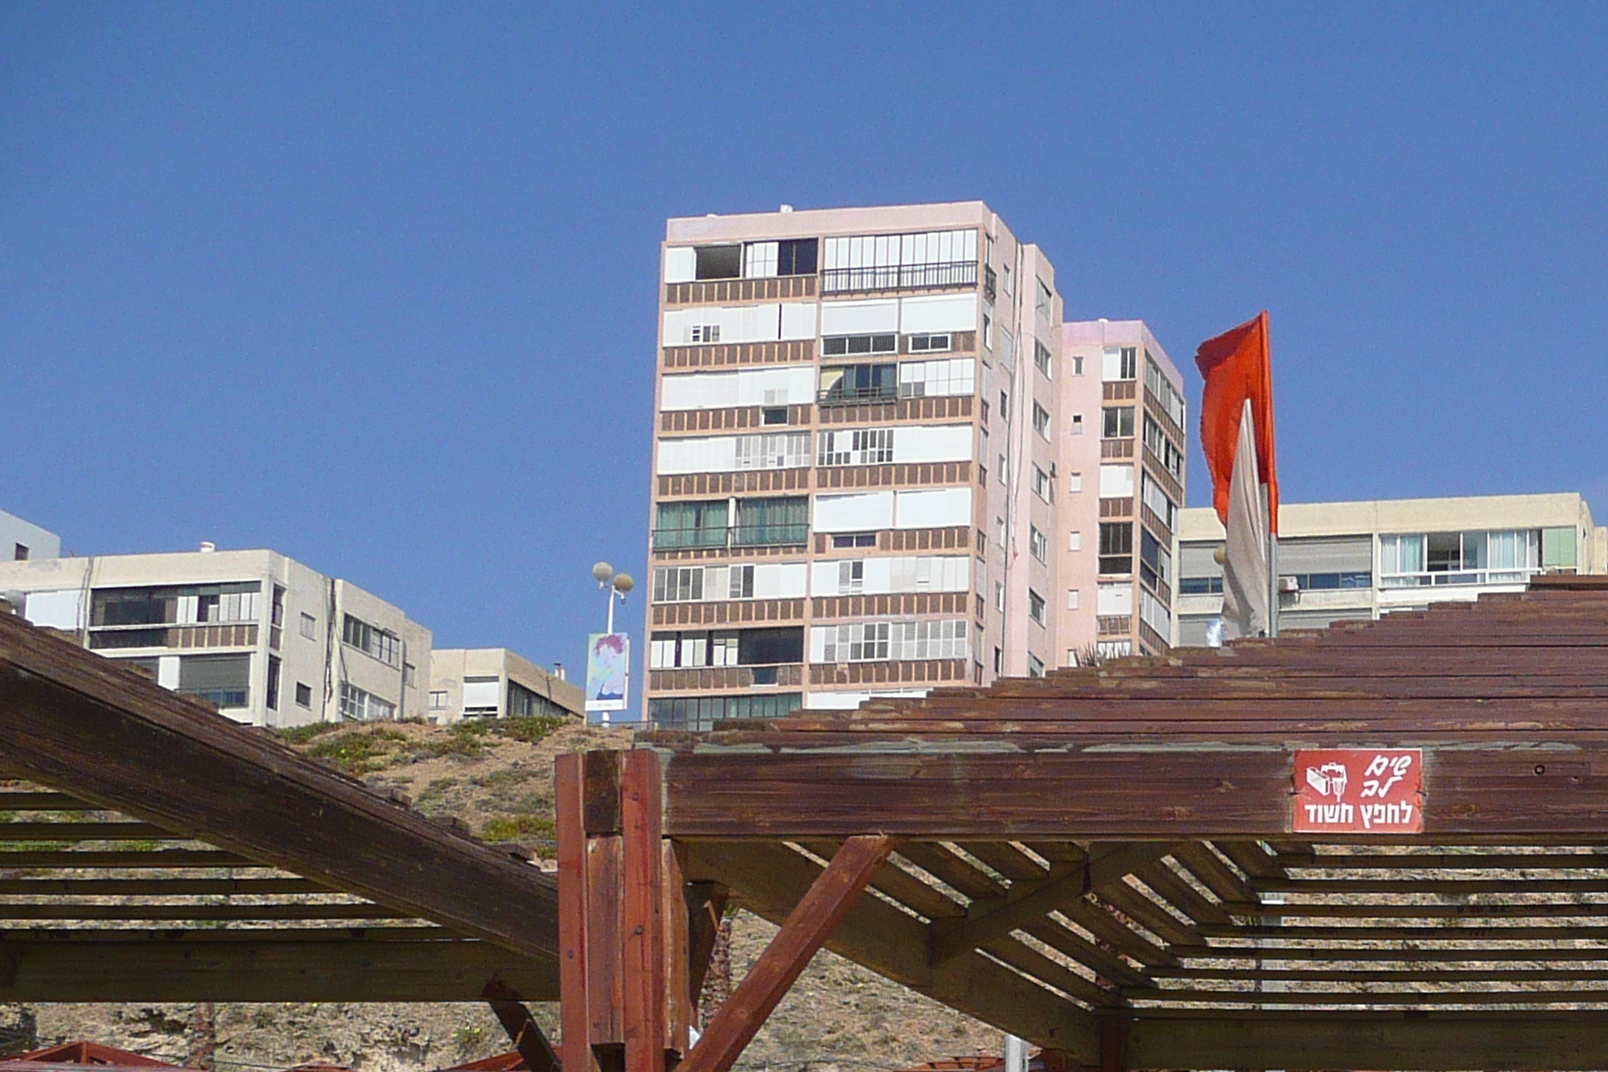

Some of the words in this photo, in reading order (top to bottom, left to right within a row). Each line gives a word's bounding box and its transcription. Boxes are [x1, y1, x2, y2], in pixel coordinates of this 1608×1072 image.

[1364, 754, 1412, 776] שים
[1360, 775, 1403, 798] לב
[1304, 803, 1354, 824] חשוד
[1360, 800, 1413, 829] לחפץ
